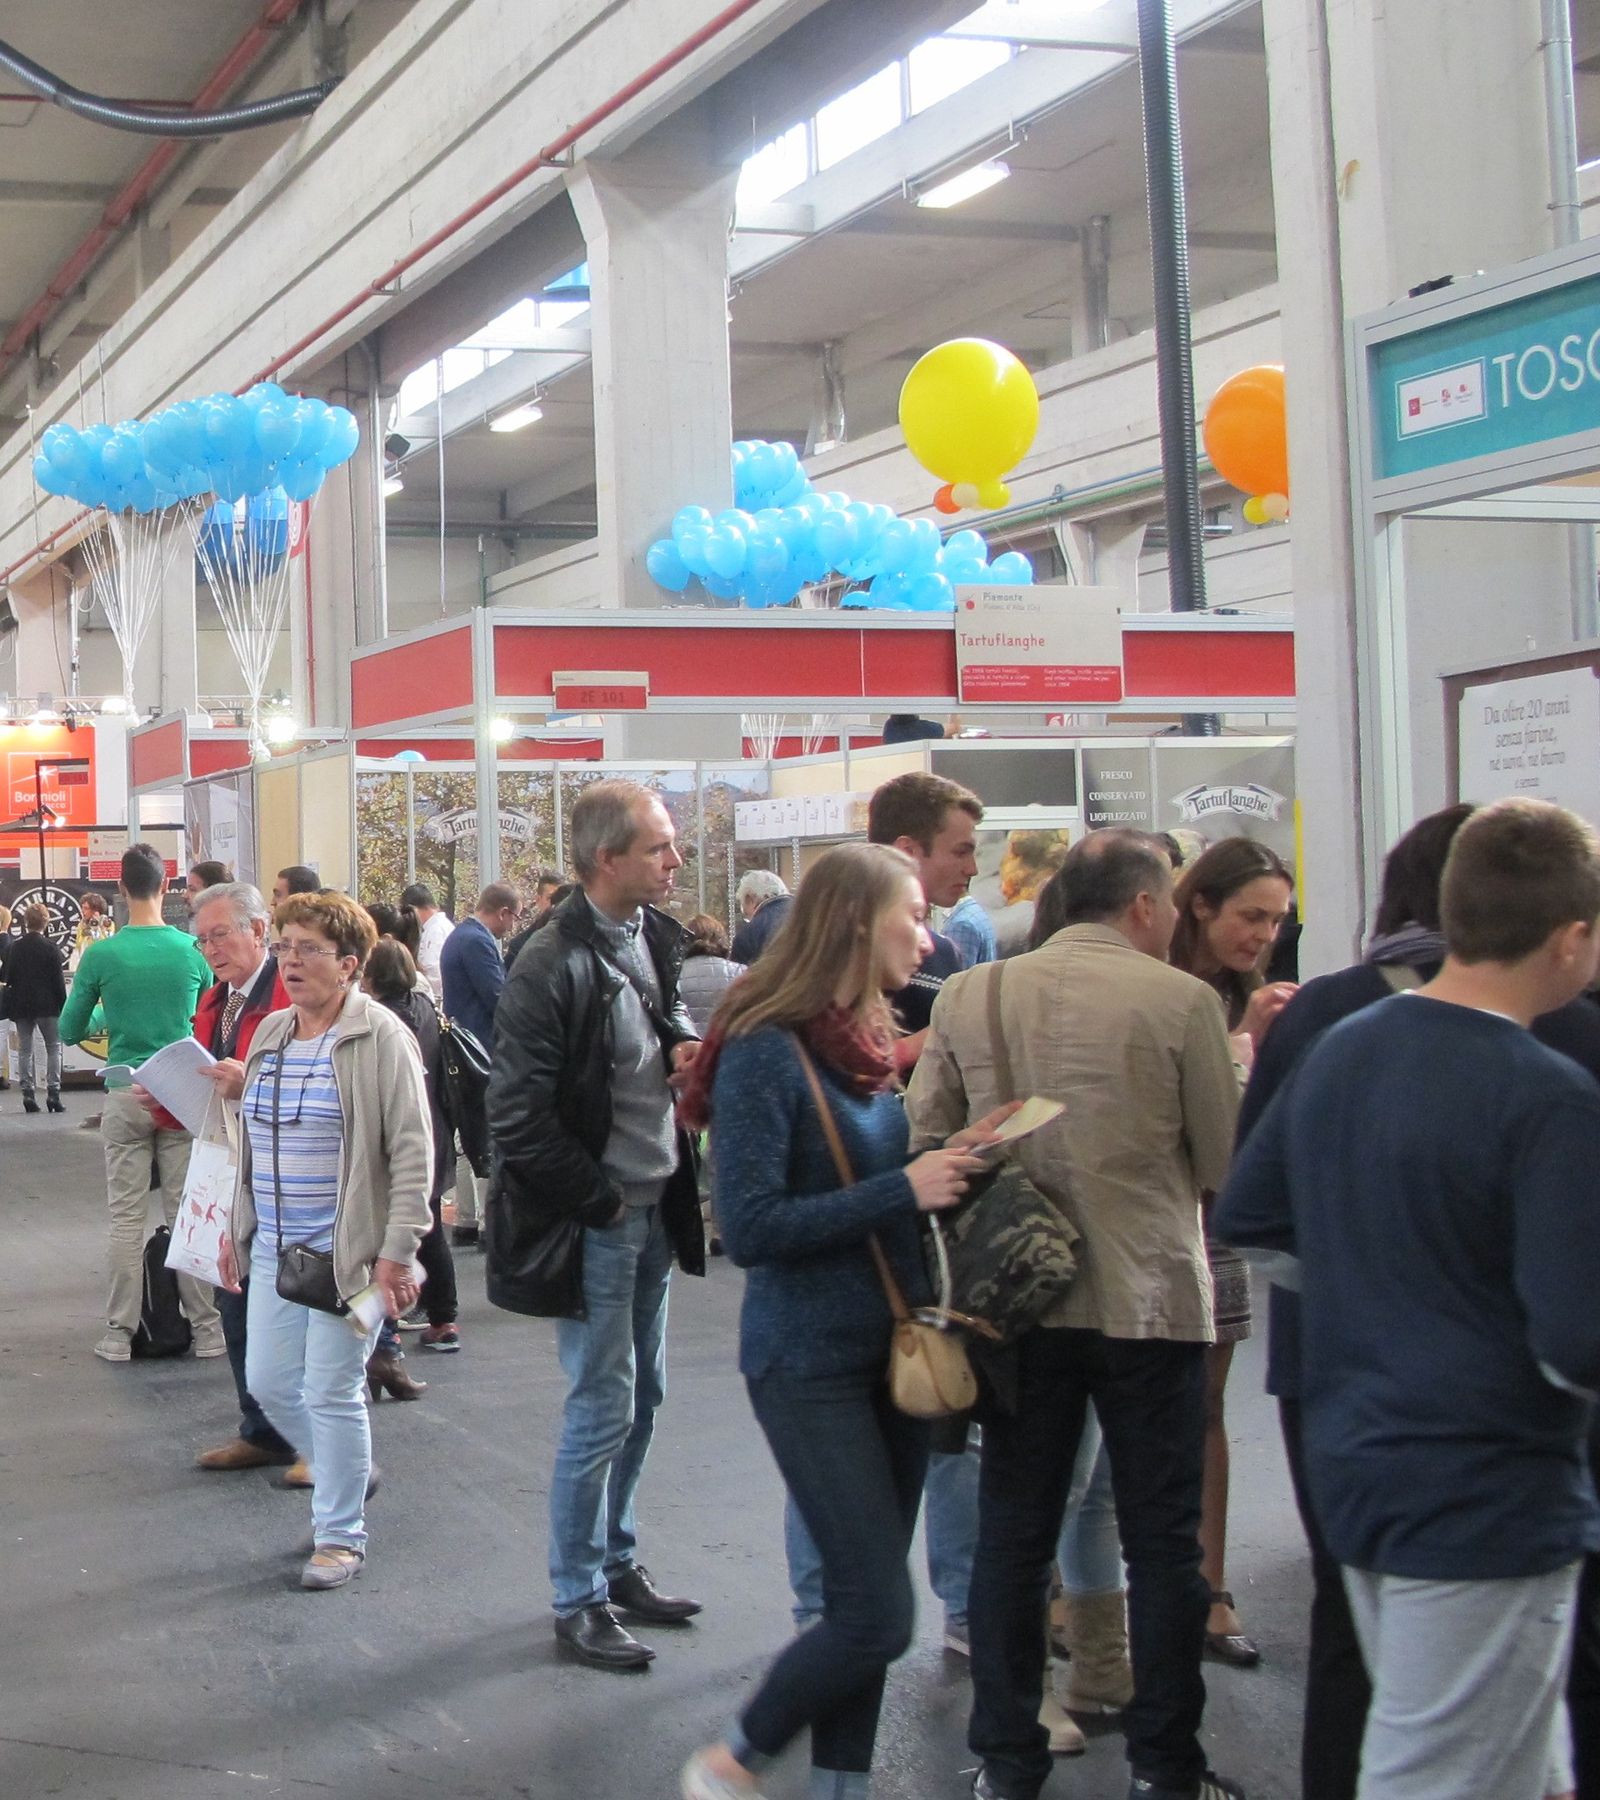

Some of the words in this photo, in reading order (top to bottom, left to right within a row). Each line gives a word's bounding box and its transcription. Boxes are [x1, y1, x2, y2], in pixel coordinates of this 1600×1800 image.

[960, 633, 1045, 651] Tartuflanghe
[1527, 699, 1542, 719] 20
[1544, 694, 1570, 717] anni
[1100, 771, 1133, 780] FRESCO
[1089, 792, 1146, 801] CONSERVATO
